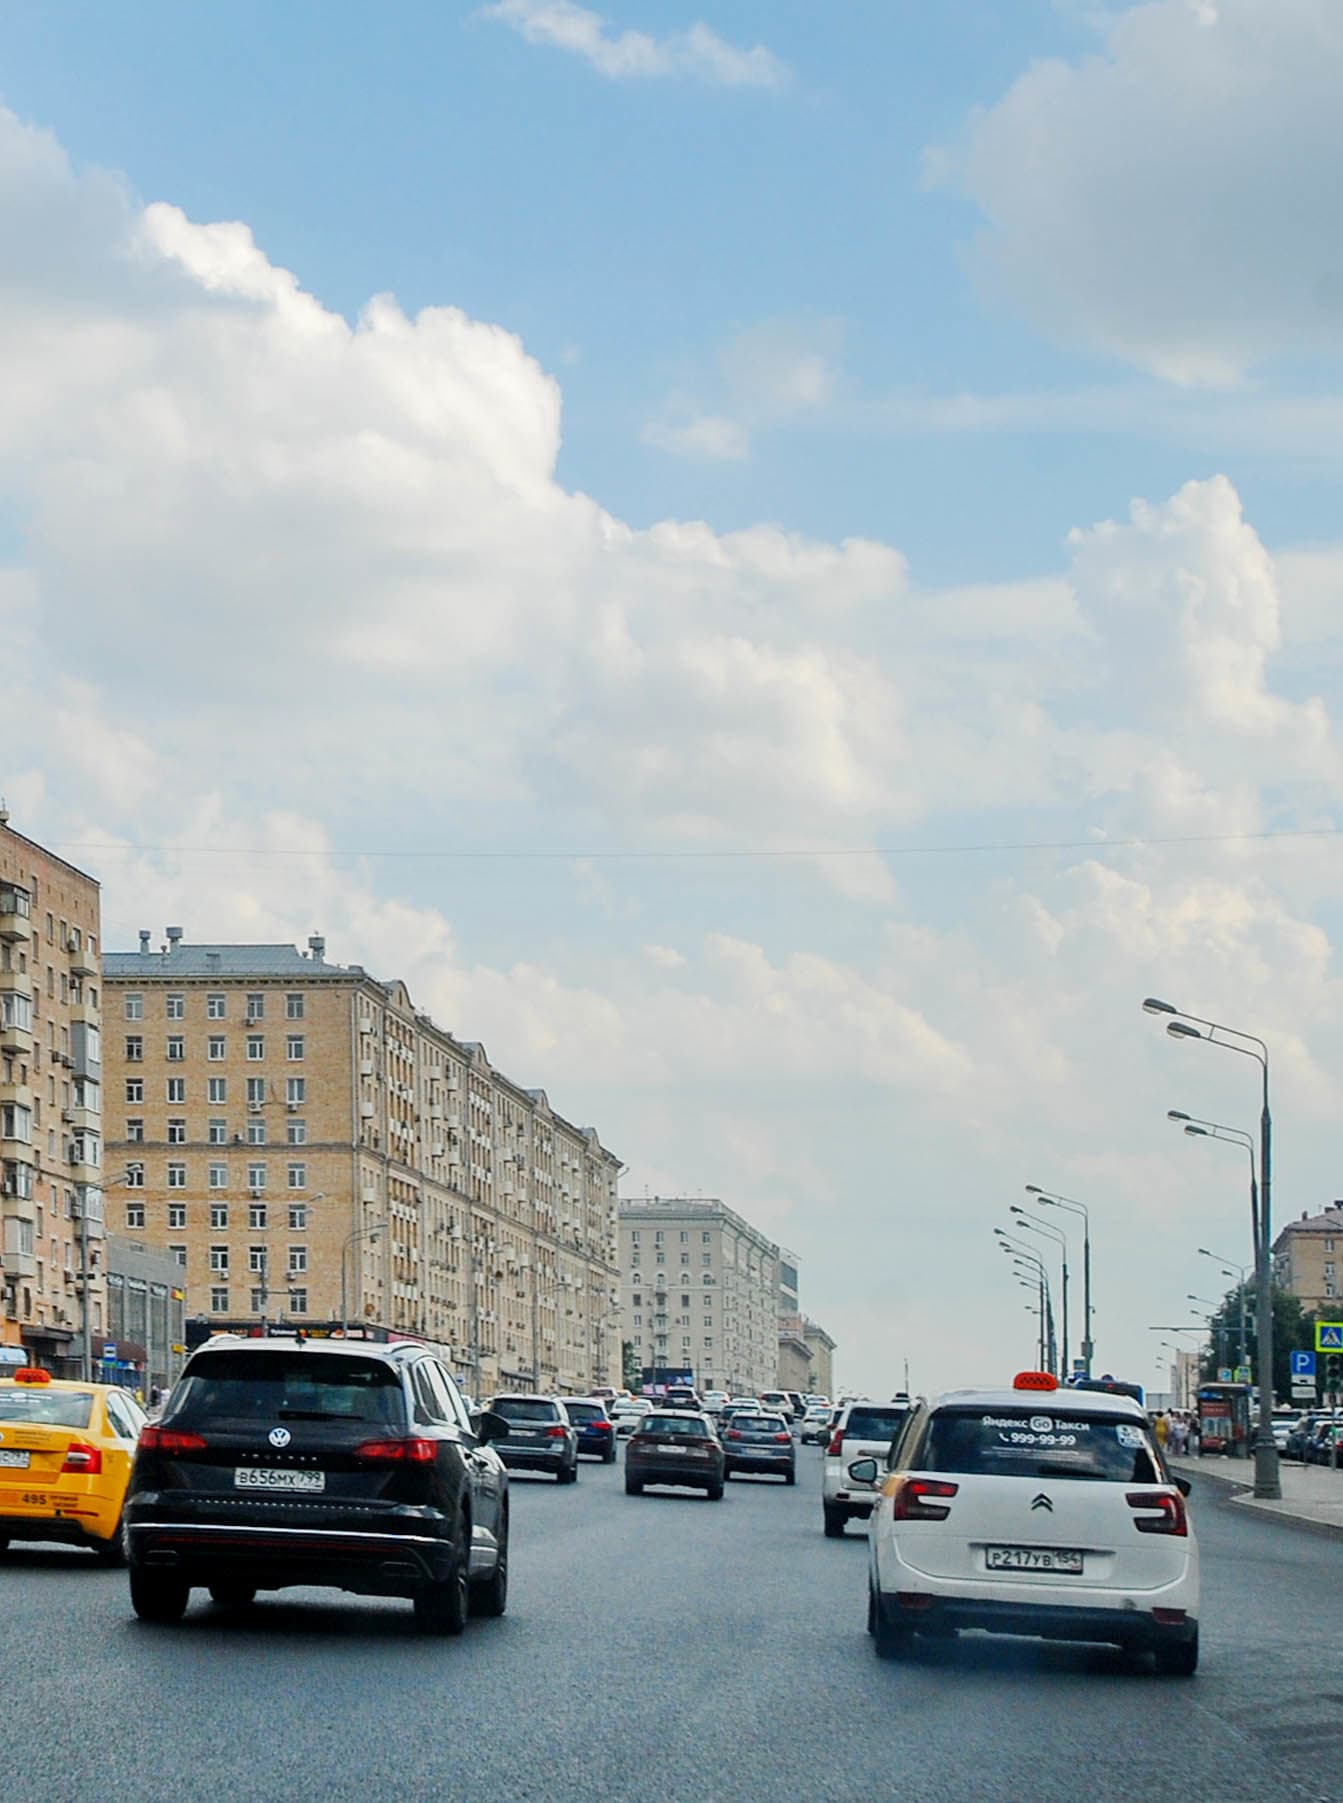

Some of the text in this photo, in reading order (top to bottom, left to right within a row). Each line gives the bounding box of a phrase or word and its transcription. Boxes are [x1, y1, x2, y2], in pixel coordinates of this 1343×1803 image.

[982, 1415, 1028, 1429] Яндекс
[1054, 1419, 1090, 1431] Такси
[1011, 1432, 1077, 1446] 999-99-99
[239, 1469, 296, 1486] В656МХ
[22, 1493, 47, 1505] 495
